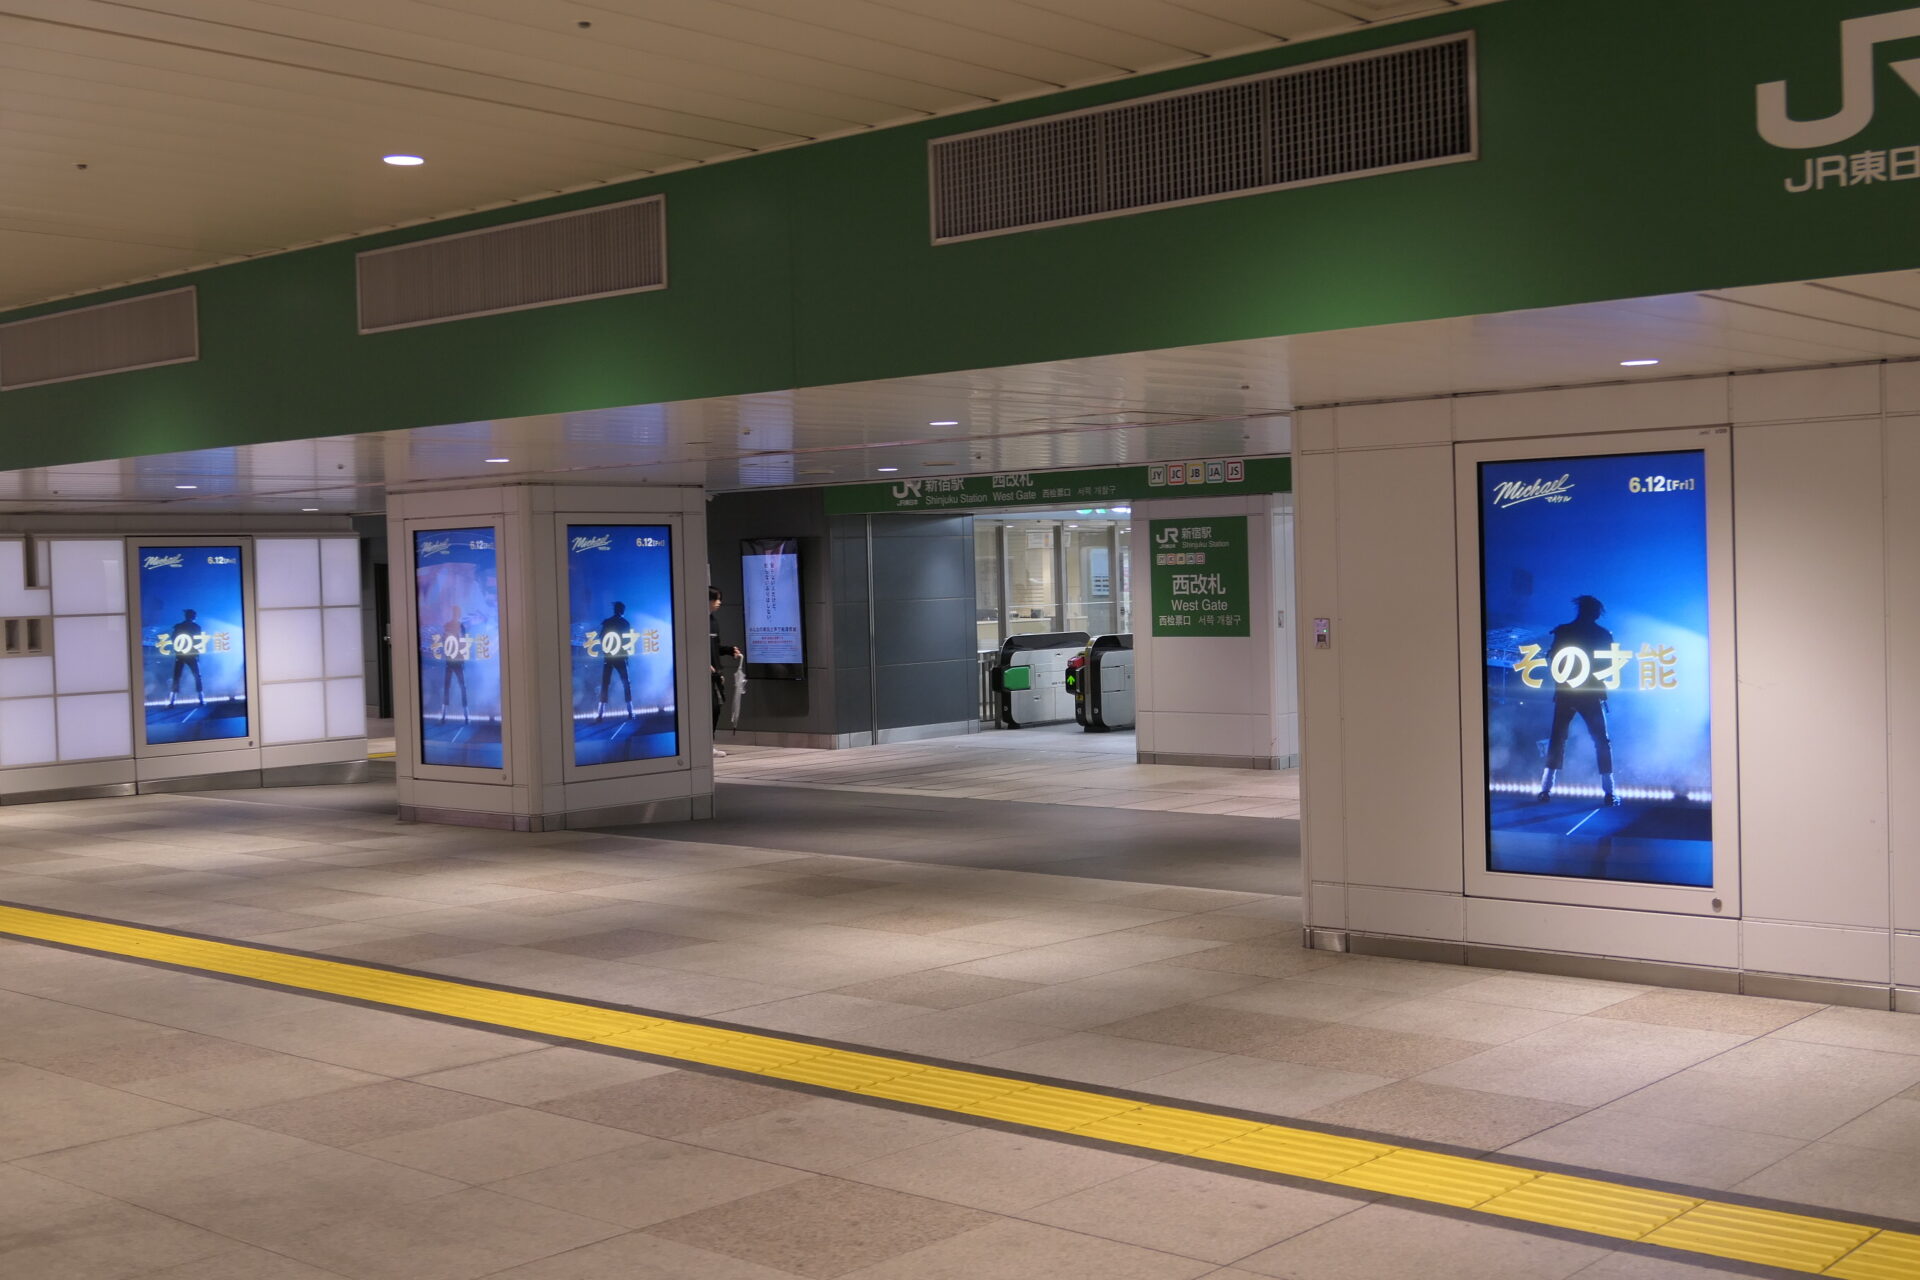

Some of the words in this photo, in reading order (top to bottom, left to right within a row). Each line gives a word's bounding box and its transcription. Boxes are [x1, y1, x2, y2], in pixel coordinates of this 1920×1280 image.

[1152, 471, 1162, 480] JY
[1171, 470, 1181, 479] JC
[1191, 468, 1200, 478] JB
[1209, 467, 1220, 477] JA
[1230, 466, 1239, 476] JS
[925, 477, 965, 492] 新宿駅
[992, 473, 1033, 488] 西改札
[892, 480, 922, 498] JR
[992, 491, 1015, 501] West
[1015, 490, 1036, 500] Gate
[1493, 473, 1575, 507] Michael
[925, 495, 959, 506] Shinjuku
[960, 493, 988, 503] Station
[1156, 527, 1179, 543] JR
[1181, 526, 1212, 539] 新宿駅
[1182, 541, 1207, 549] Shinjuku
[1172, 573, 1226, 595] 西改札
[1171, 599, 1199, 611] West
[1202, 599, 1228, 611] Gate
[155, 631, 231, 655] その才能
[431, 633, 490, 660] その才能
[583, 628, 660, 657] その才能
[1513, 643, 1678, 690] その才能
